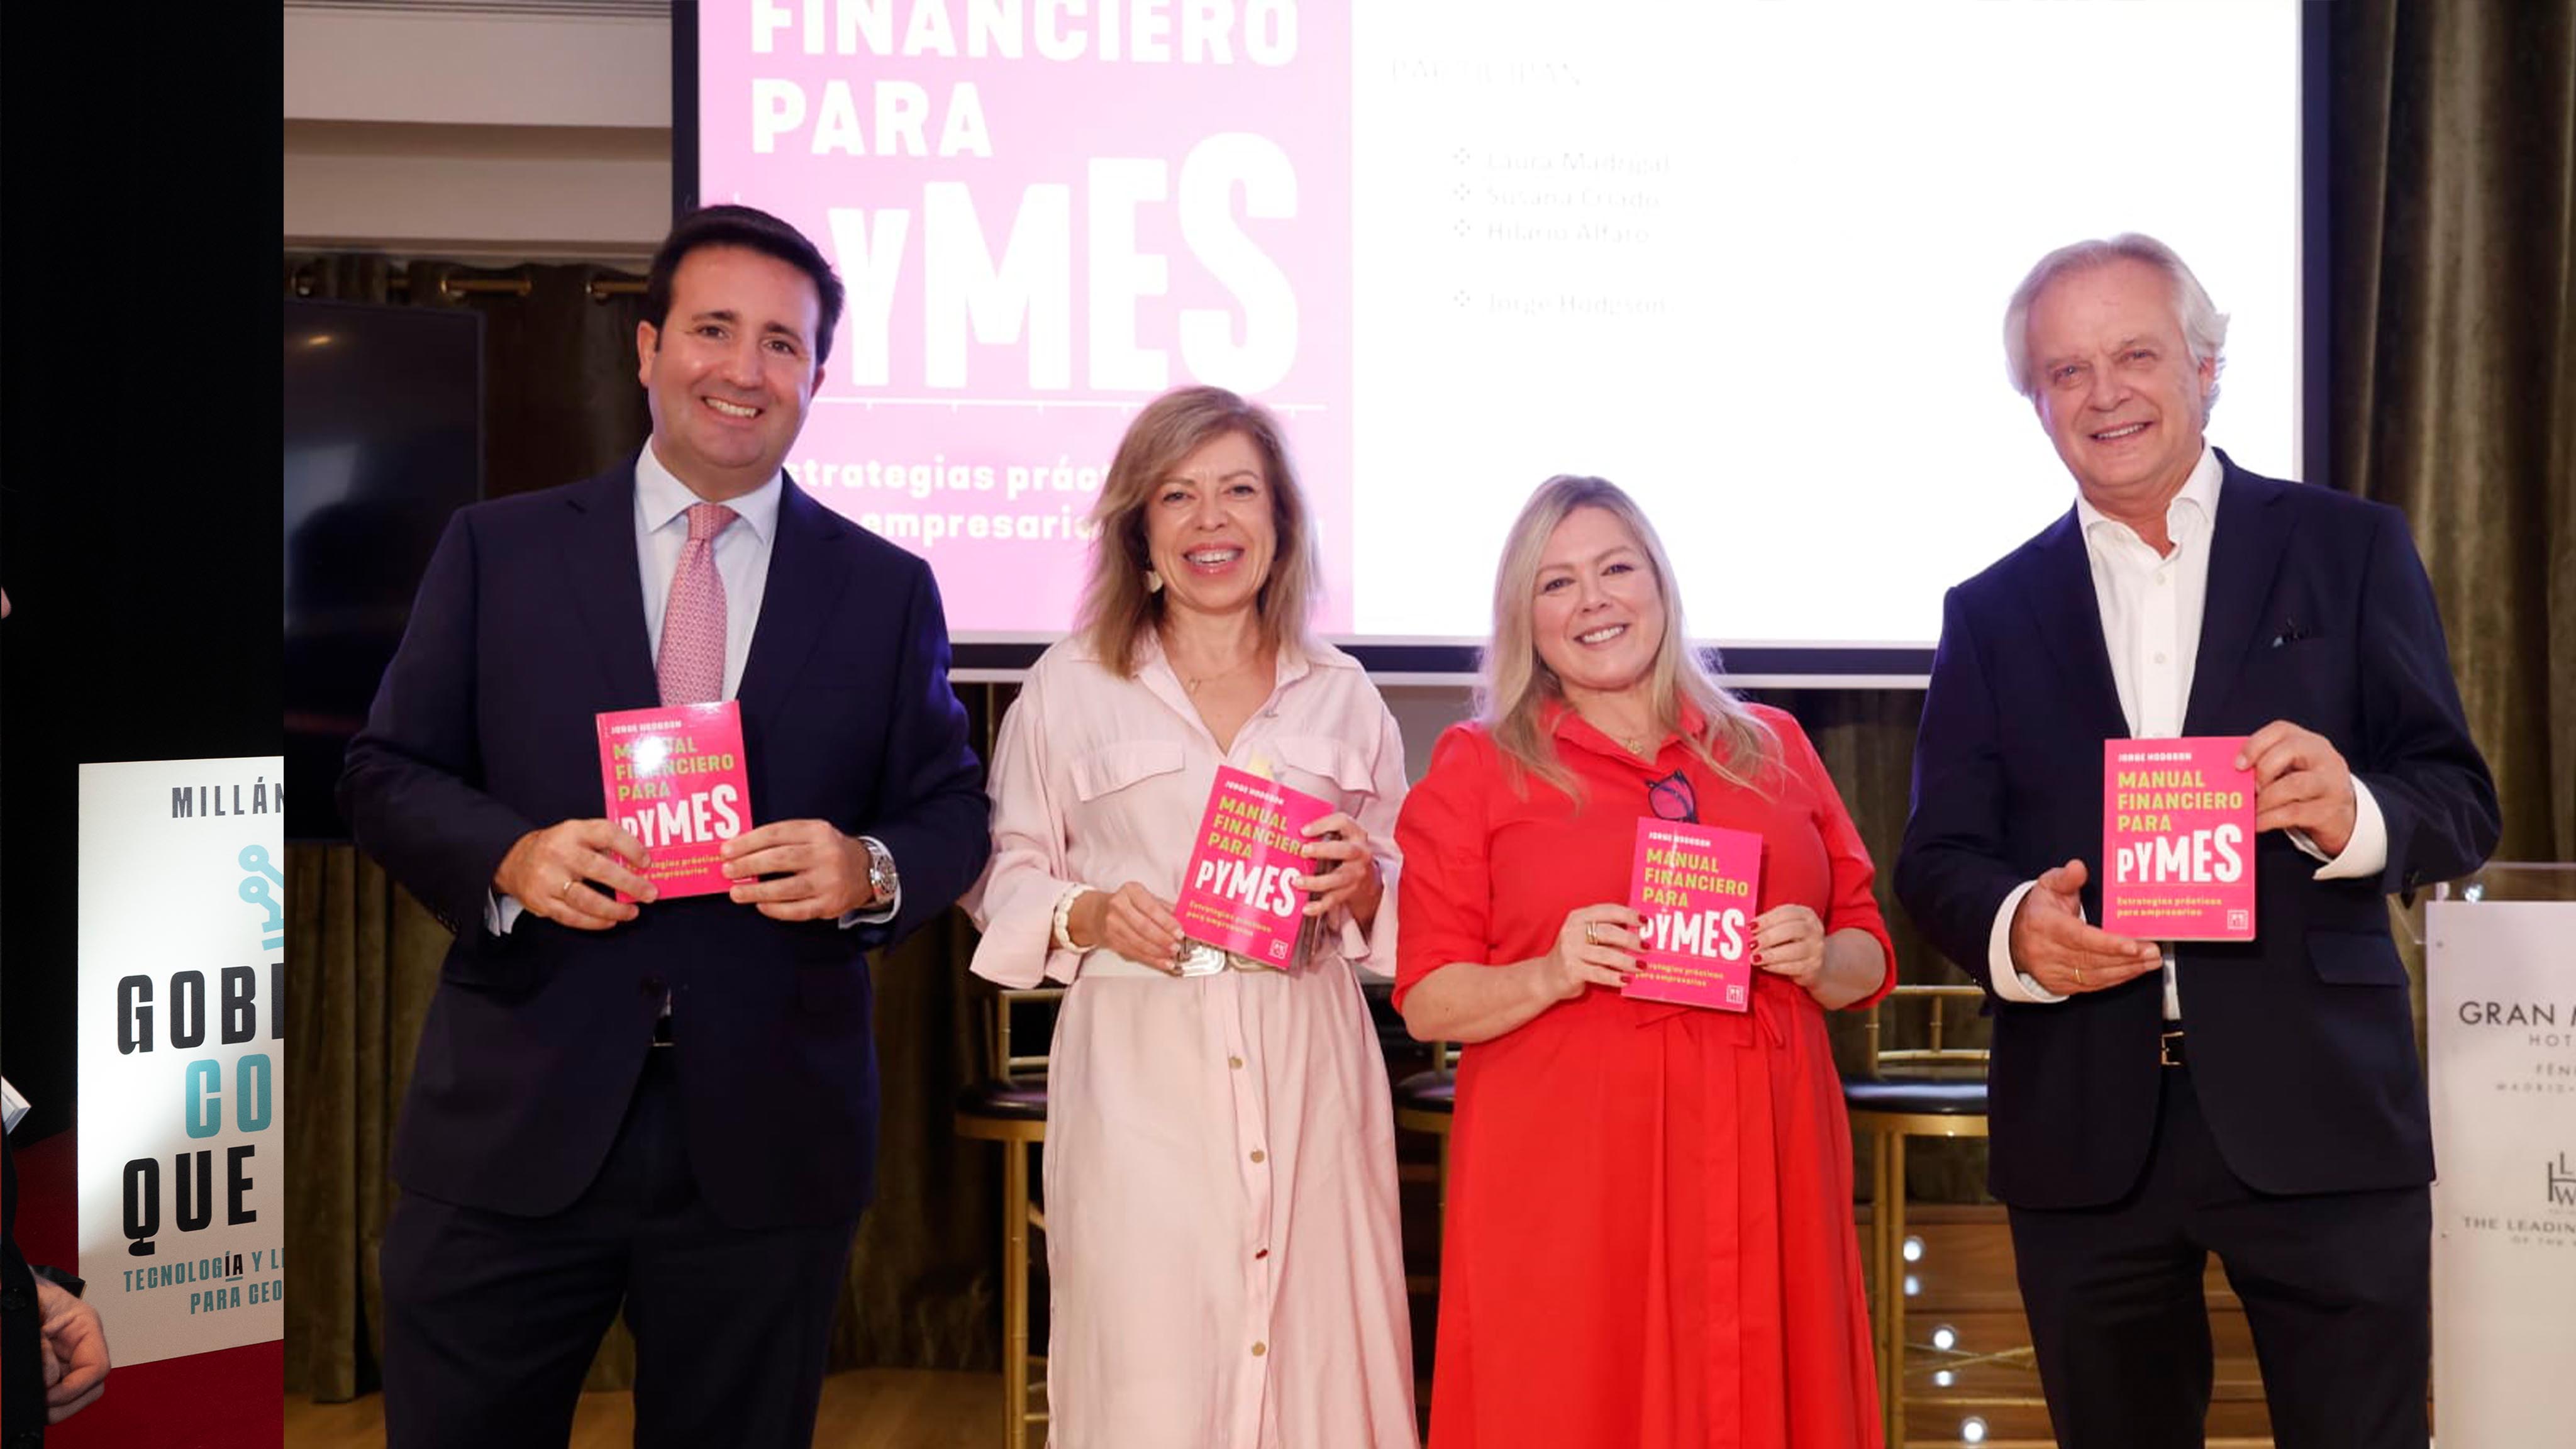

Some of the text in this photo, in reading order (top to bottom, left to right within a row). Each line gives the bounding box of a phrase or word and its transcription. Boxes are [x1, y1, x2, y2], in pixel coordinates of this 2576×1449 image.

[752, 0, 1299, 67] FINANCIERO
[752, 77, 994, 158] PARA
[828, 131, 1299, 393] YMES
[784, 454, 996, 499] strategias
[618, 781, 671, 802] PARA
[2118, 770, 2206, 789] MANUAL
[1218, 796, 1288, 830] MANUAL
[2117, 791, 2244, 811] FINANCIERO
[2117, 814, 2172, 833] PARA
[1207, 832, 1253, 858] PARA
[2116, 823, 2243, 884] PYMES
[1646, 847, 1720, 874] MANUAL
[1195, 858, 1302, 918] PYMES
[1641, 886, 1689, 908] PARA
[1644, 867, 1749, 897] FINANCIERO
[2459, 1001, 2555, 1026] GRAN
[123, 1145, 257, 1257] QUE
[123, 1251, 243, 1292] TECNOLOGÍA
[252, 1250, 263, 1273] Y
[191, 1286, 241, 1315] PARA
